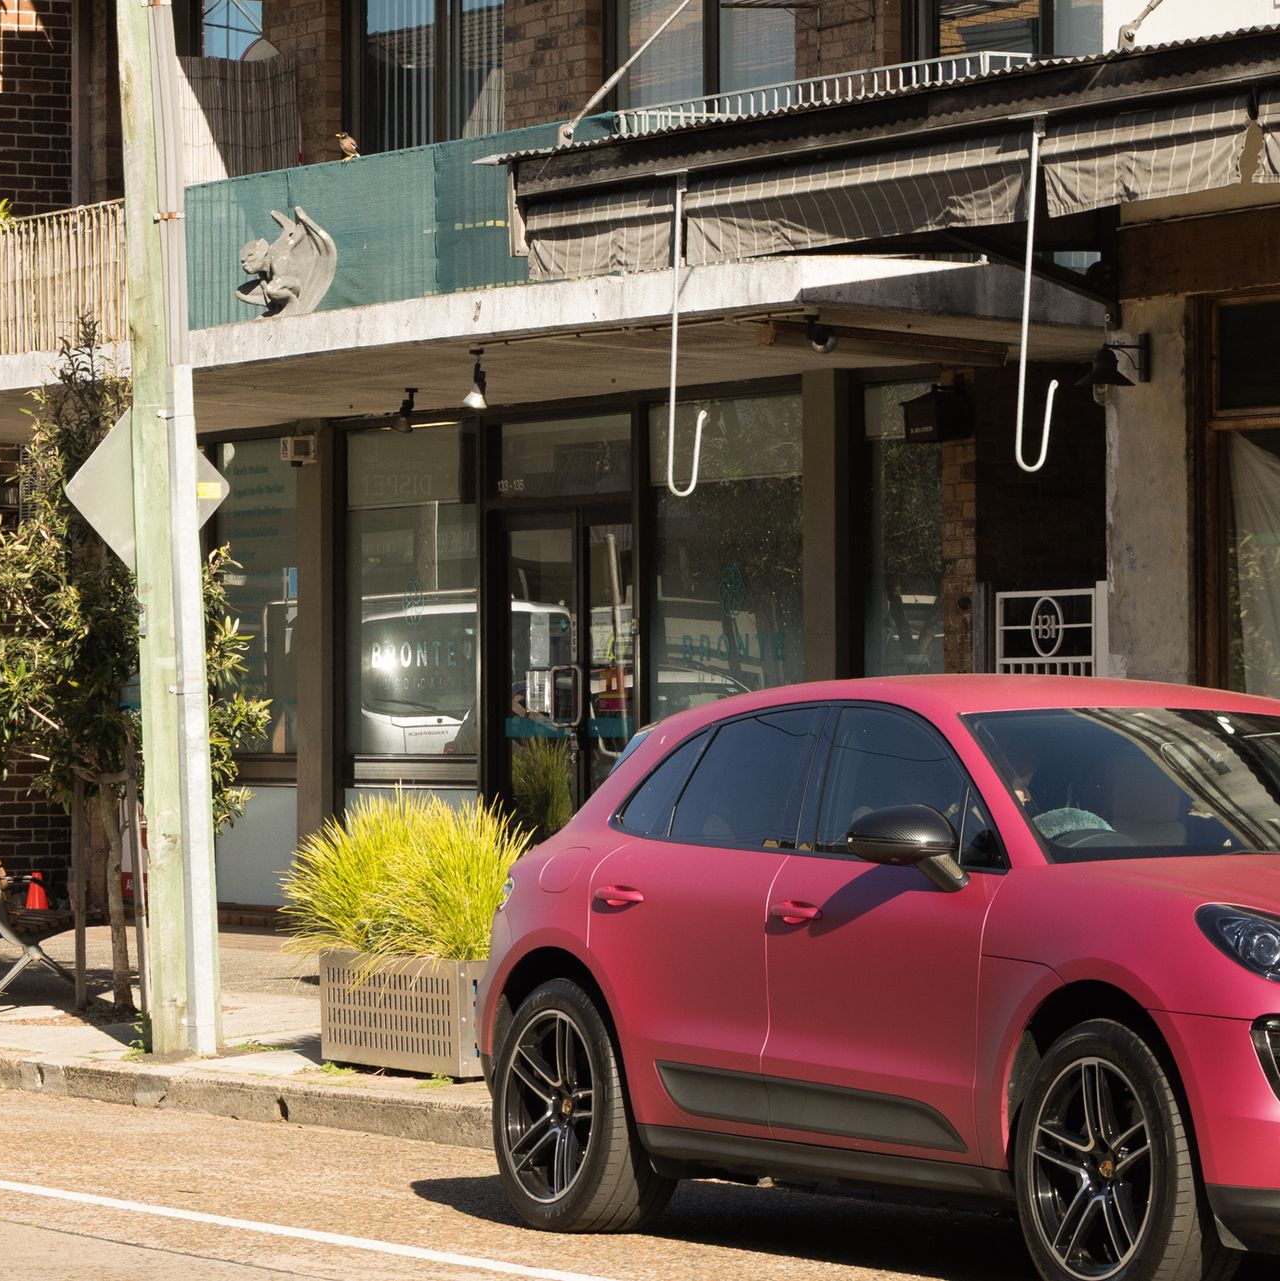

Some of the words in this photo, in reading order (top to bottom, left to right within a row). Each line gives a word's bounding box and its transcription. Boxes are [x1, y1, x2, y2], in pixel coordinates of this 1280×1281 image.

[1037, 614, 1057, 640] 131
[371, 640, 457, 668] BRONTE
[682, 631, 785, 663] BRONTE
